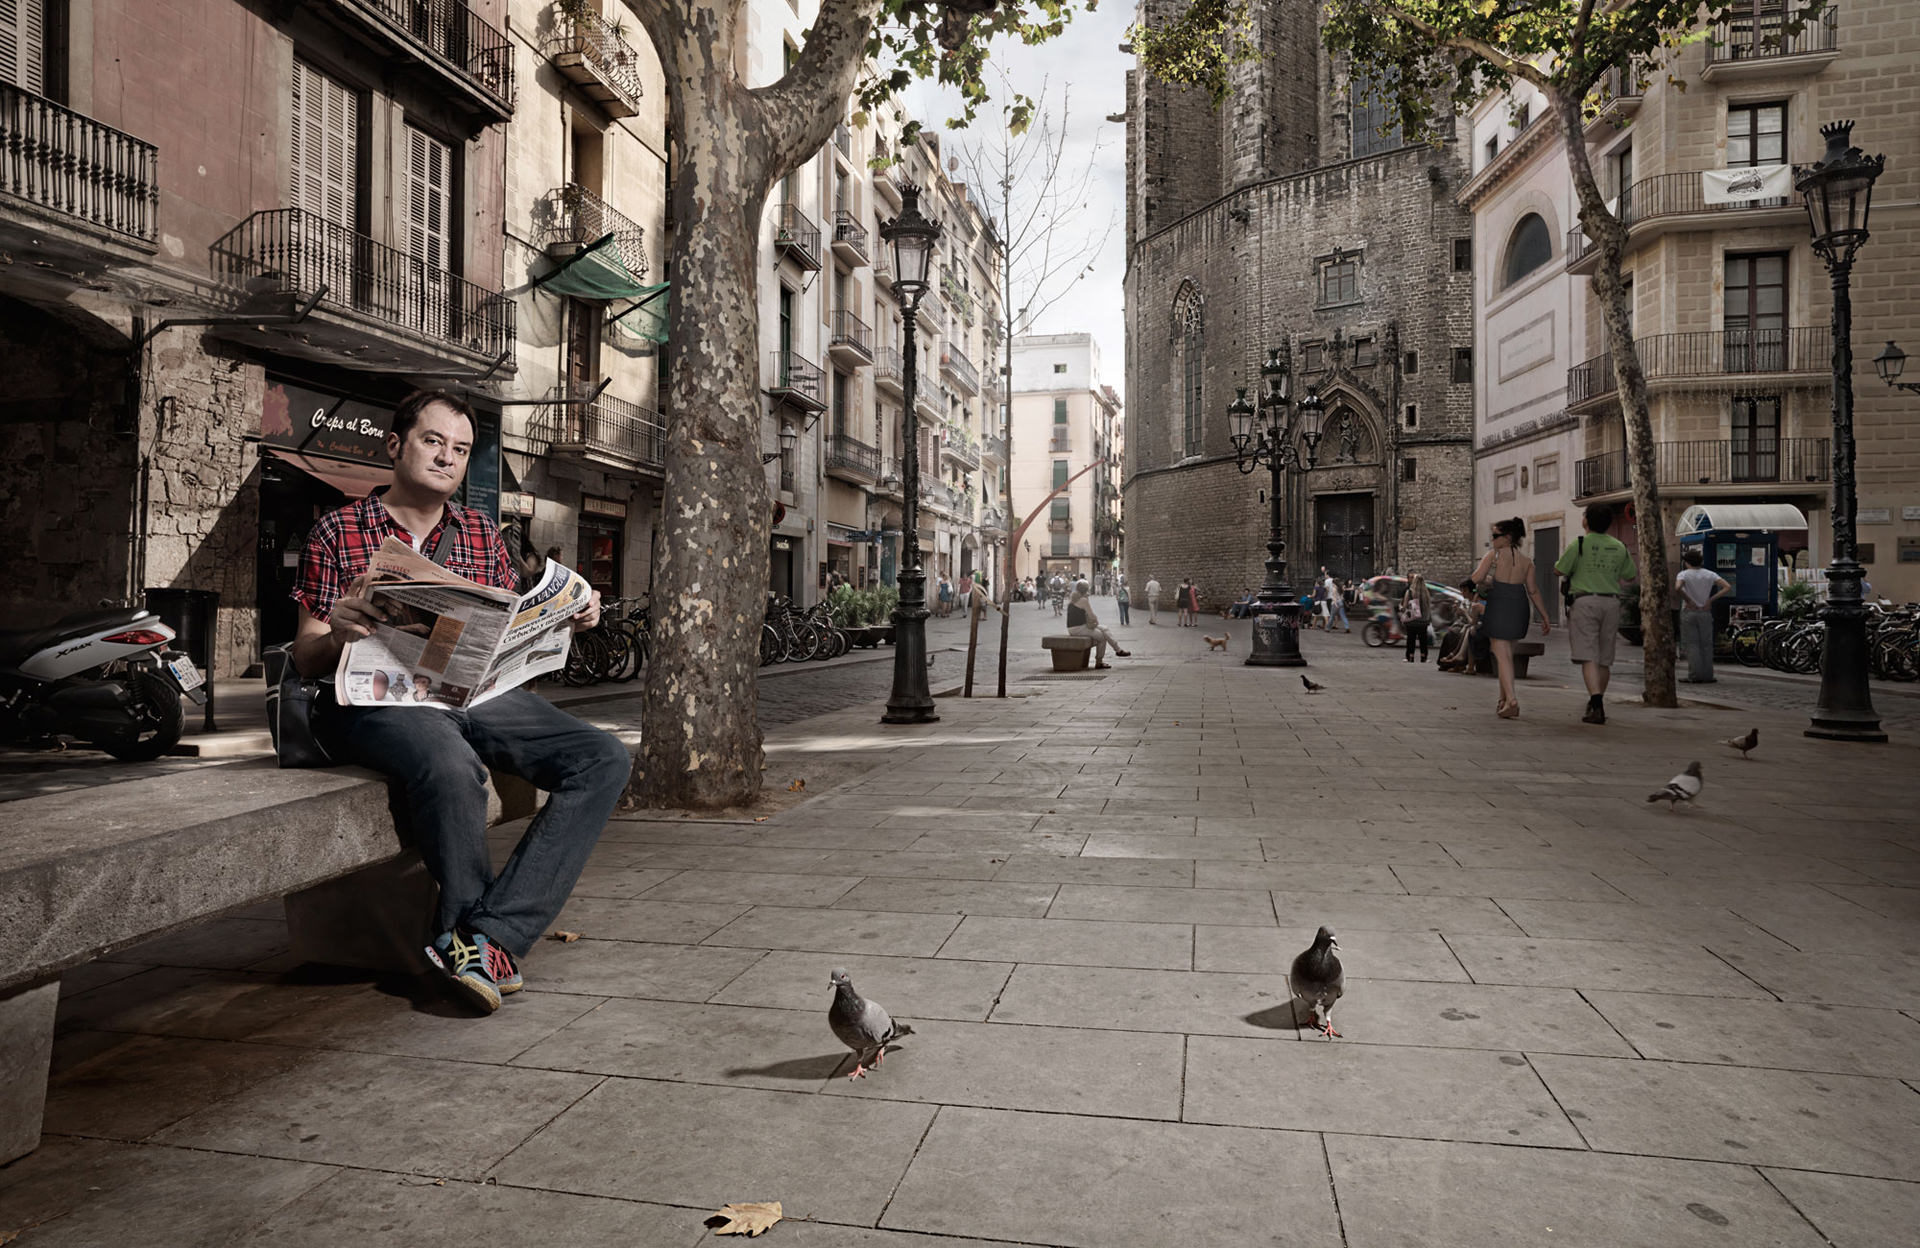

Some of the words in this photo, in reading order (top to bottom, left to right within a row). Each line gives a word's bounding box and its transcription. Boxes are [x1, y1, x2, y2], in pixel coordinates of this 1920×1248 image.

[312, 408, 344, 431] Creps
[346, 417, 358, 431] al
[359, 418, 385, 438] Born
[521, 598, 535, 610] LA
